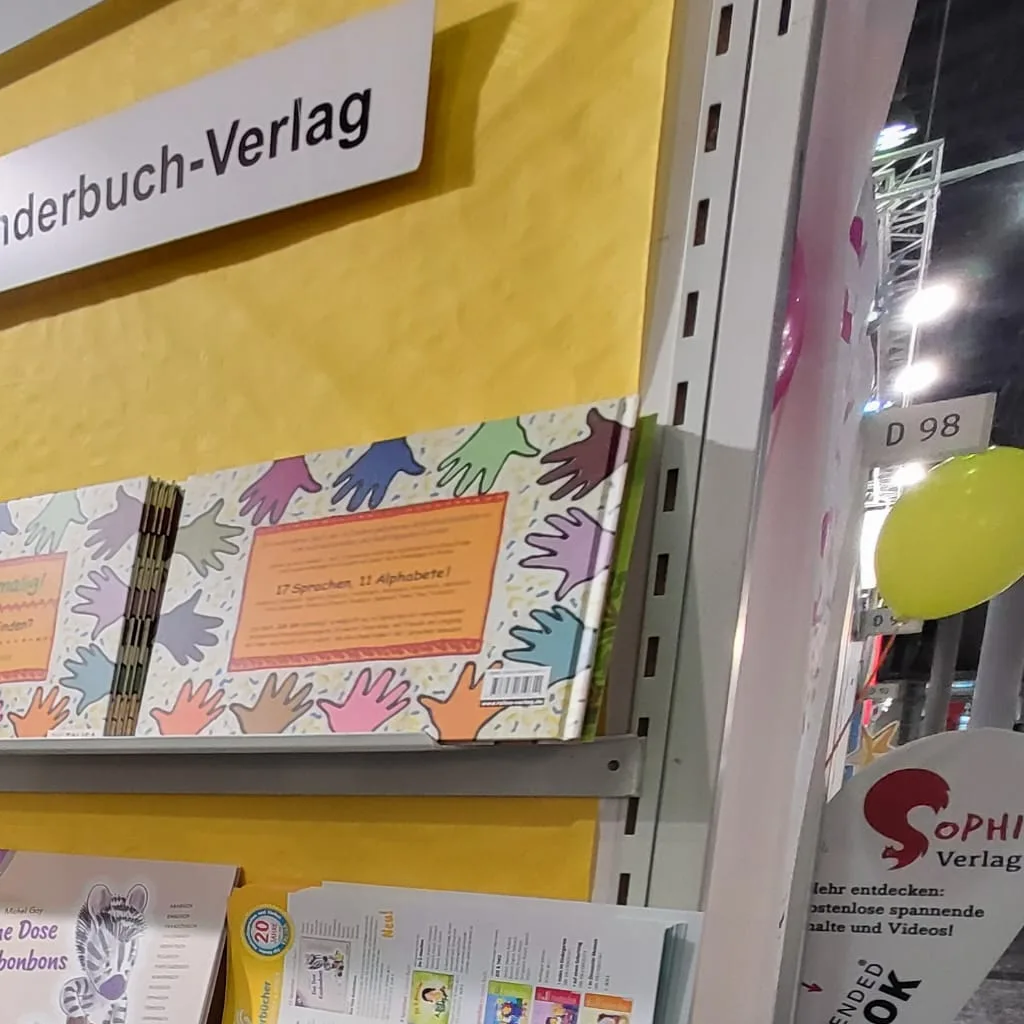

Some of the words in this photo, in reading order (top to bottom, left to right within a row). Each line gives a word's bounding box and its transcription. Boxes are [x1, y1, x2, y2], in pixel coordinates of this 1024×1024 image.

[886, 422, 905, 446] D
[919, 414, 961, 442] 98
[276, 584, 290, 595] 17
[376, 565, 451, 586] Alphabete!
[936, 850, 1023, 873] Verlag
[851, 883, 945, 898] entdecken:
[889, 904, 985, 919] spannende
[18, 919, 58, 940] Dose
[254, 920, 269, 943] 20
[380, 911, 396, 939] Neu!
[851, 921, 882, 934] und
[888, 922, 954, 937] Videos!
